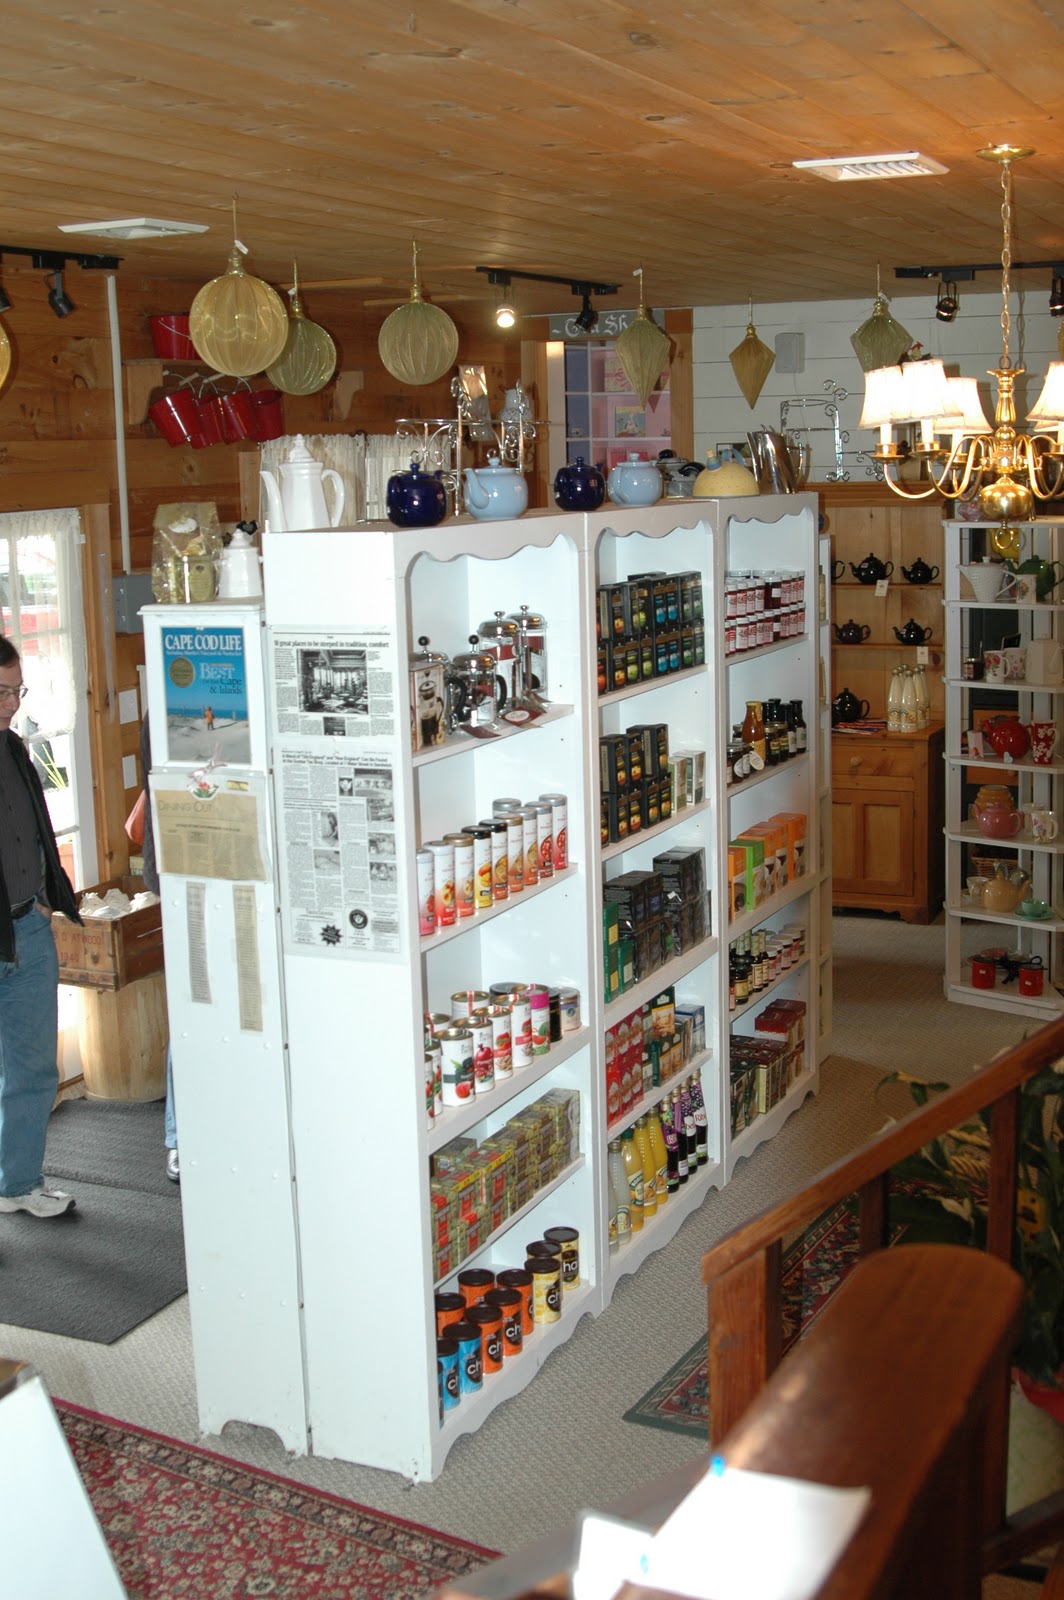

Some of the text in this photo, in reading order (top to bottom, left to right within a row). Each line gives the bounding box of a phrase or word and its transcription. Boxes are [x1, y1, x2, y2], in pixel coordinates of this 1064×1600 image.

[565, 317, 599, 337] Ta
[165, 634, 242, 651] CAPE COD LIFE
[220, 675, 242, 688] Cape
[209, 686, 242, 695] & Islands
